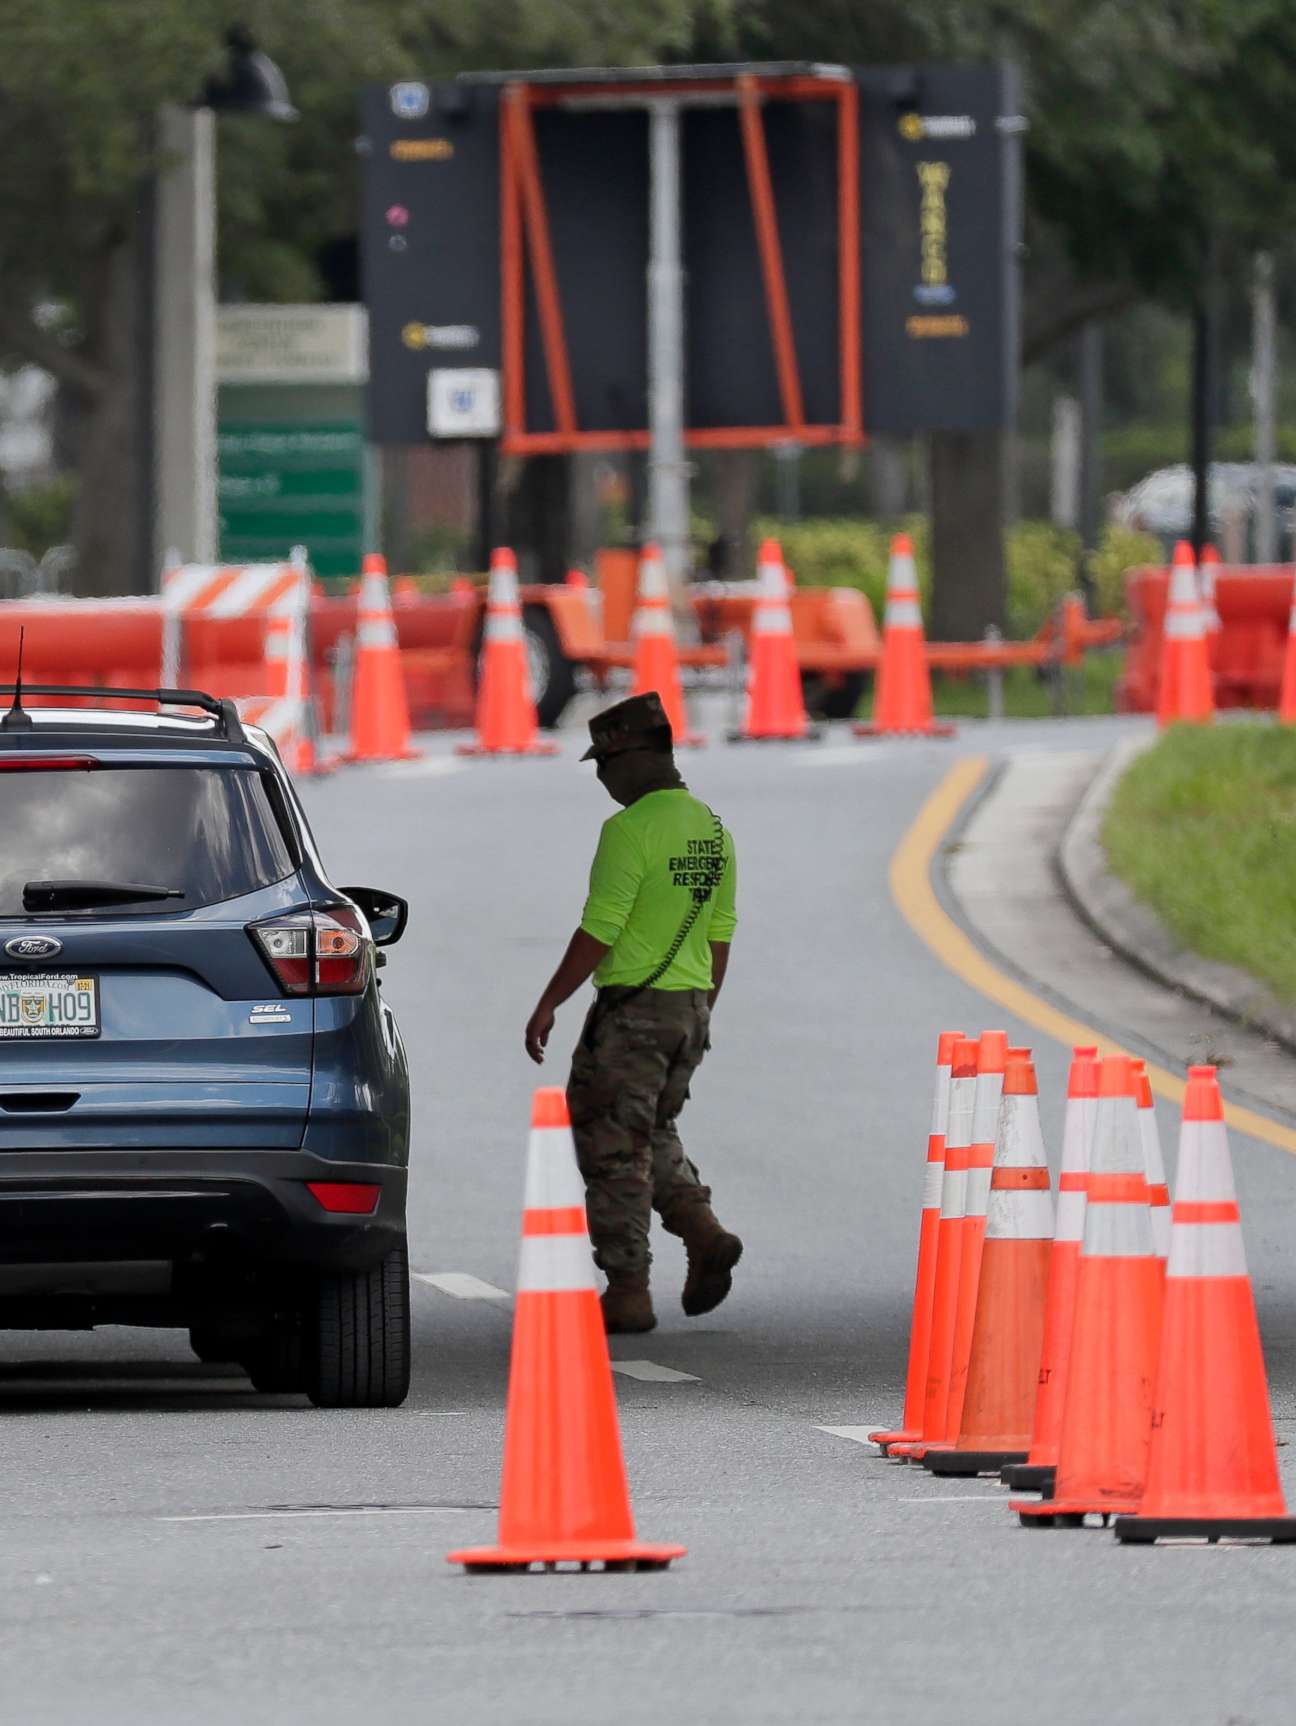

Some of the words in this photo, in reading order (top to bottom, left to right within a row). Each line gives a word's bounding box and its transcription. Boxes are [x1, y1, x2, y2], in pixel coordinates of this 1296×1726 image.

[687, 839, 720, 855] STATE
[48, 992, 91, 1021] H09
[251, 1004, 288, 1013] SEL
[0, 1027, 30, 1037] BEAUTIFUL
[31, 1027, 51, 1036] SOUTH
[51, 1026, 79, 1036] ORLANDO
